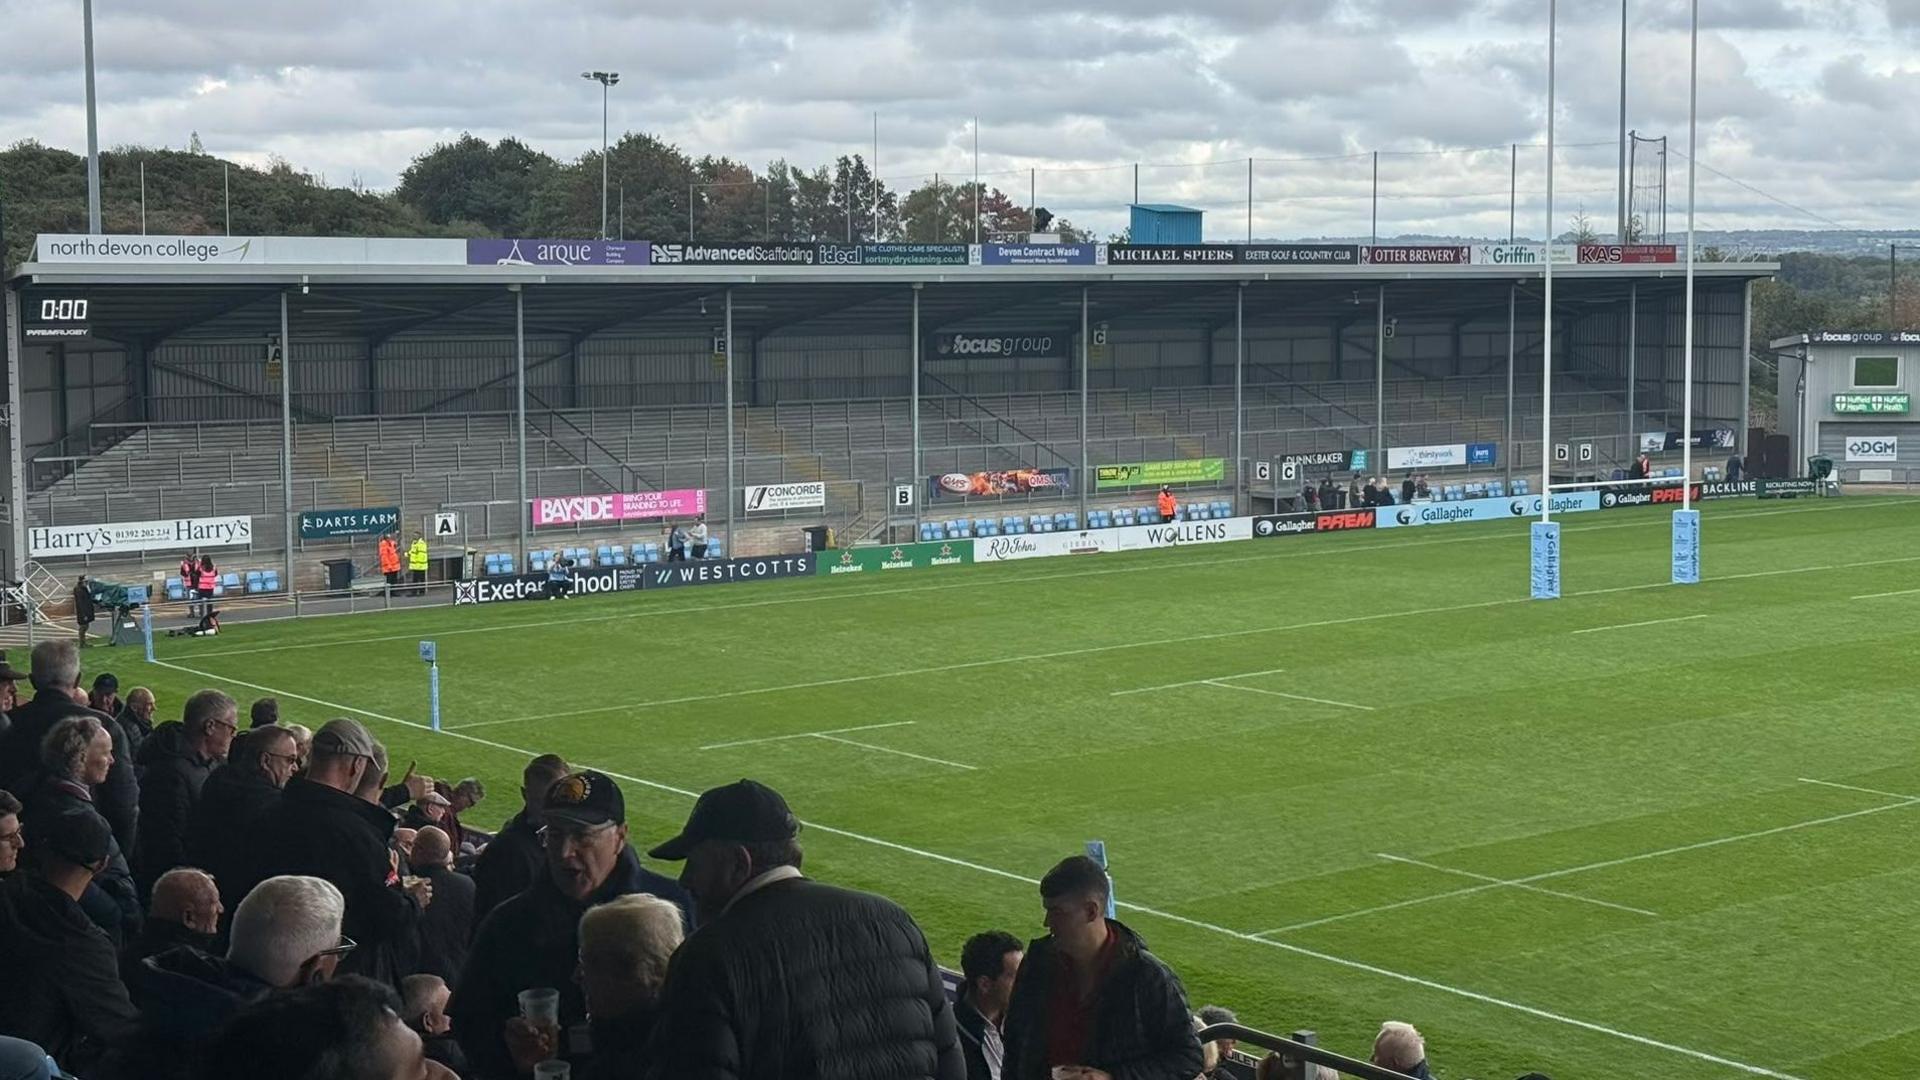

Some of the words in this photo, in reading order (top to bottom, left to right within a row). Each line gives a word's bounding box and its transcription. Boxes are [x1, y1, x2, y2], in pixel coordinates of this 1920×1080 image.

[50, 238, 95, 256] north
[98, 238, 152, 257] devon
[156, 239, 219, 261] college
[537, 244, 591, 265] arque
[819, 244, 862, 265] ideal
[999, 247, 1022, 257] Devon
[1023, 247, 1056, 257] Contract
[1057, 247, 1080, 257] Waste
[1112, 249, 1180, 261] MICHAEL
[1183, 249, 1234, 261] SPIERS
[1245, 250, 1270, 260] EXETER
[1271, 250, 1291, 260] GOLF
[1292, 250, 1298, 260] &
[1299, 250, 1333, 260] COUNTRY
[1333, 250, 1351, 260] CLUB
[1375, 249, 1408, 262] OTTER
[1409, 249, 1456, 262] BREWERY
[1493, 247, 1535, 263] Griffin
[1580, 246, 1622, 264] KAS
[865, 256, 965, 265] sortmydrycleaning.co.uk
[41, 299, 88, 320] 0:00
[1095, 332, 1104, 343] C
[1558, 448, 1566, 459] D
[1582, 448, 1590, 459] D
[1861, 441, 1895, 454] DGM
[1258, 466, 1268, 479] C
[1284, 466, 1293, 479] C
[942, 477, 967, 488] QMS
[1702, 481, 1756, 494] BACKLINE
[767, 484, 822, 497] CONCORDE
[899, 491, 909, 504] B
[1533, 498, 1583, 513] Gllagher
[1618, 493, 1651, 504] Gallagher
[541, 495, 613, 523] BAYSIDE
[1421, 506, 1475, 521] Gallagher
[316, 515, 357, 529] DARTS
[363, 513, 397, 526] FARM
[438, 518, 452, 534] A
[1275, 520, 1316, 532] Gallagher
[1317, 512, 1373, 531] PREM
[31, 528, 112, 553] Harry's
[115, 530, 138, 539] 01392
[174, 519, 250, 543] Harry's
[1147, 523, 1226, 544] WOLLENS
[1010, 537, 1037, 554] Johns
[680, 559, 807, 581] WESTCOTTS
[476, 579, 546, 602] Exeter
